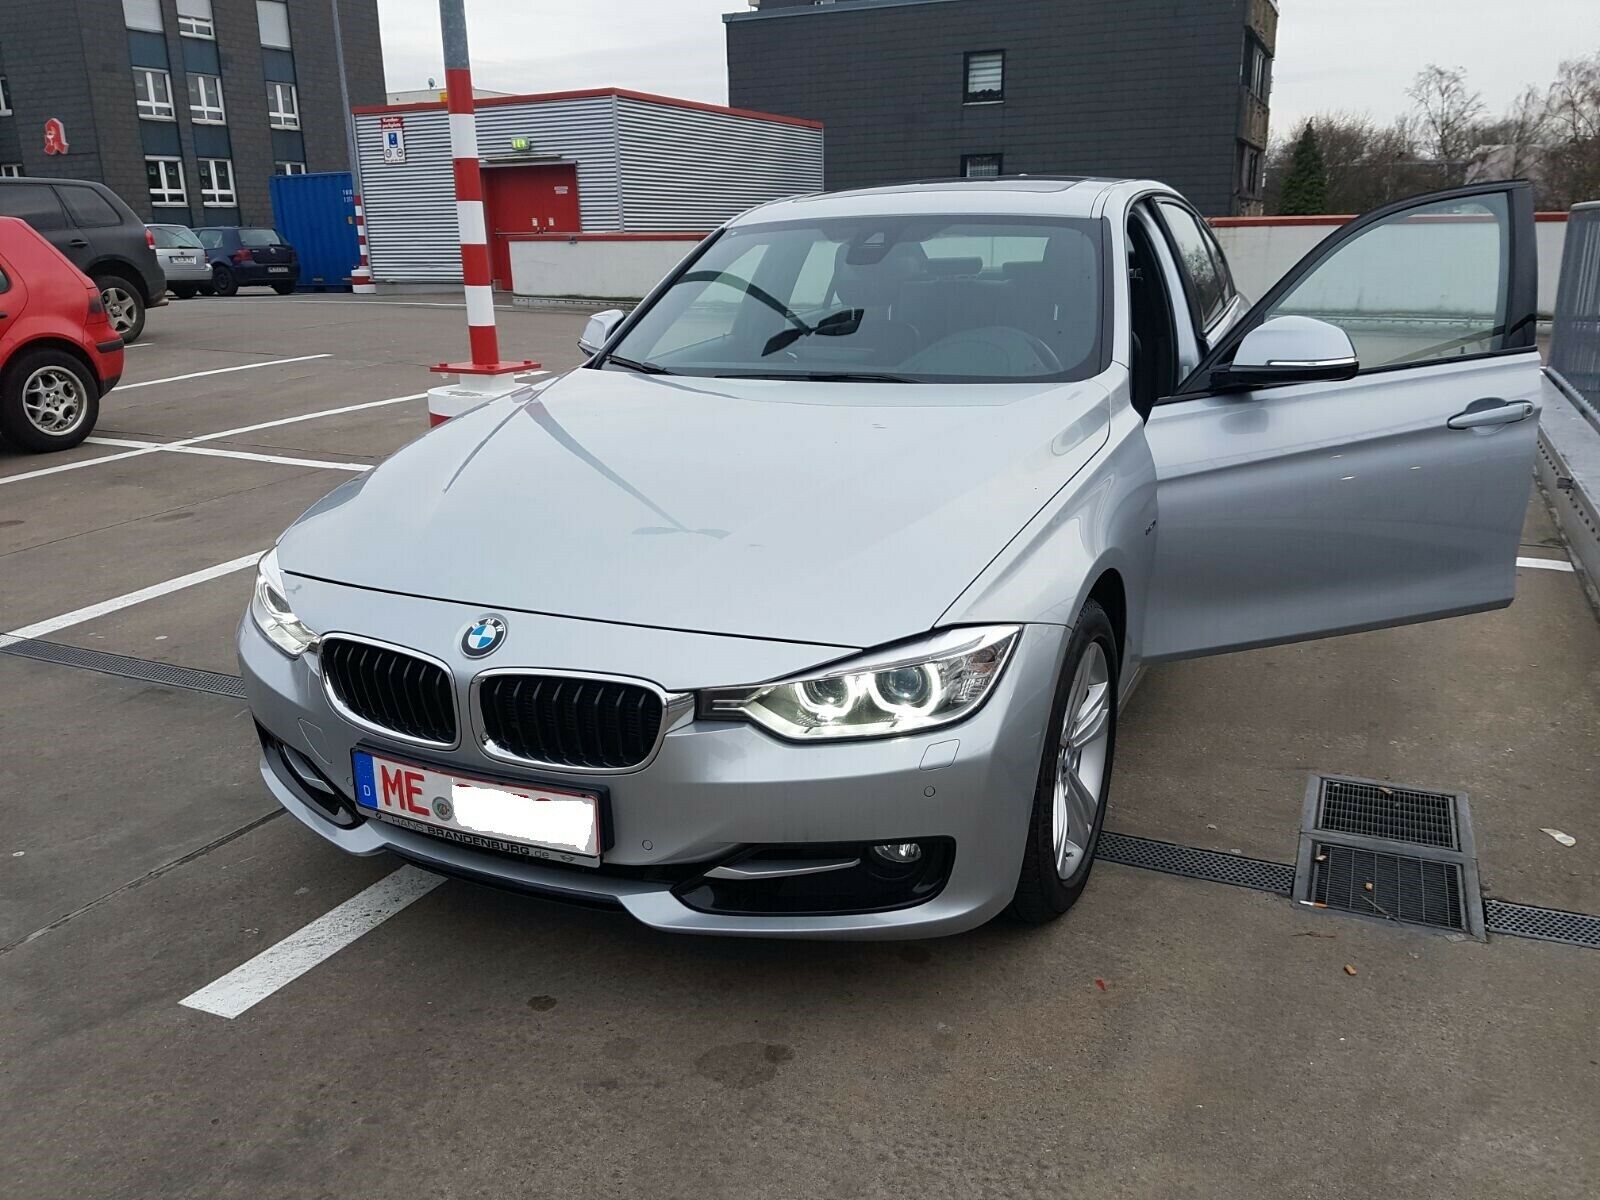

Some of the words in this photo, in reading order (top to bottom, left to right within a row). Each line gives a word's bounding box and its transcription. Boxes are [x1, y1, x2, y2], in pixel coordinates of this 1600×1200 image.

[472, 618, 504, 633] BMW
[363, 784, 371, 797] D
[381, 764, 430, 817] ME
[391, 816, 425, 832] HANS
